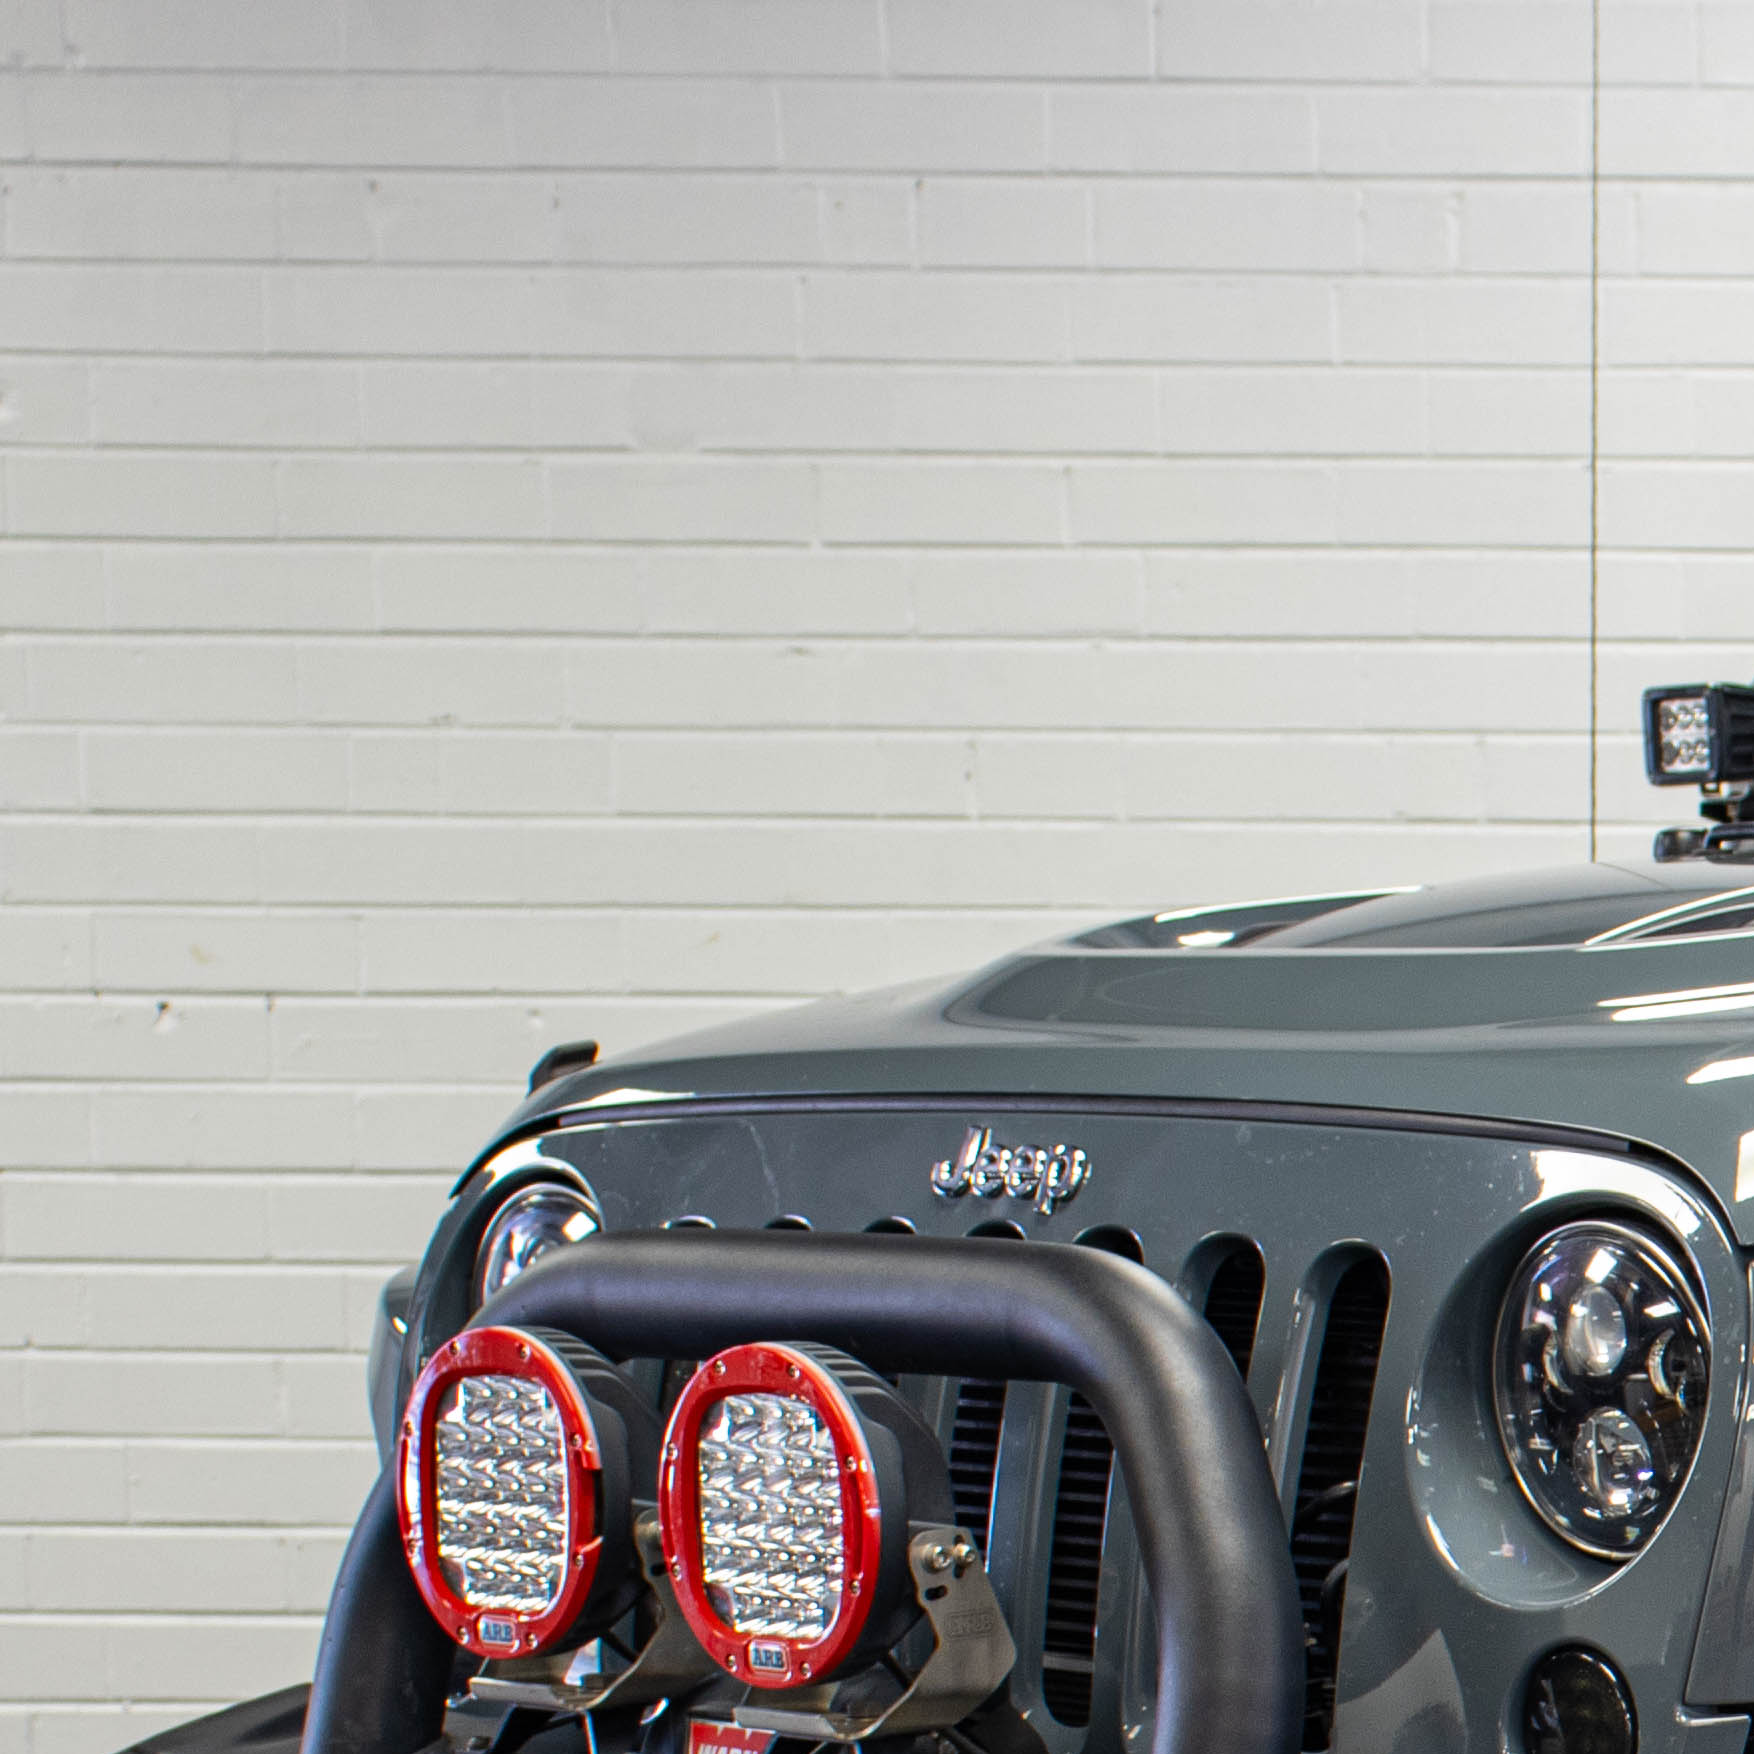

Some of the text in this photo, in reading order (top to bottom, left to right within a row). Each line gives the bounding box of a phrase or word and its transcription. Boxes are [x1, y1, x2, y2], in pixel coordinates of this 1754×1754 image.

[930, 1125, 1092, 1215] Jeep
[481, 1621, 512, 1642] ARB
[752, 1649, 784, 1670] ARB
